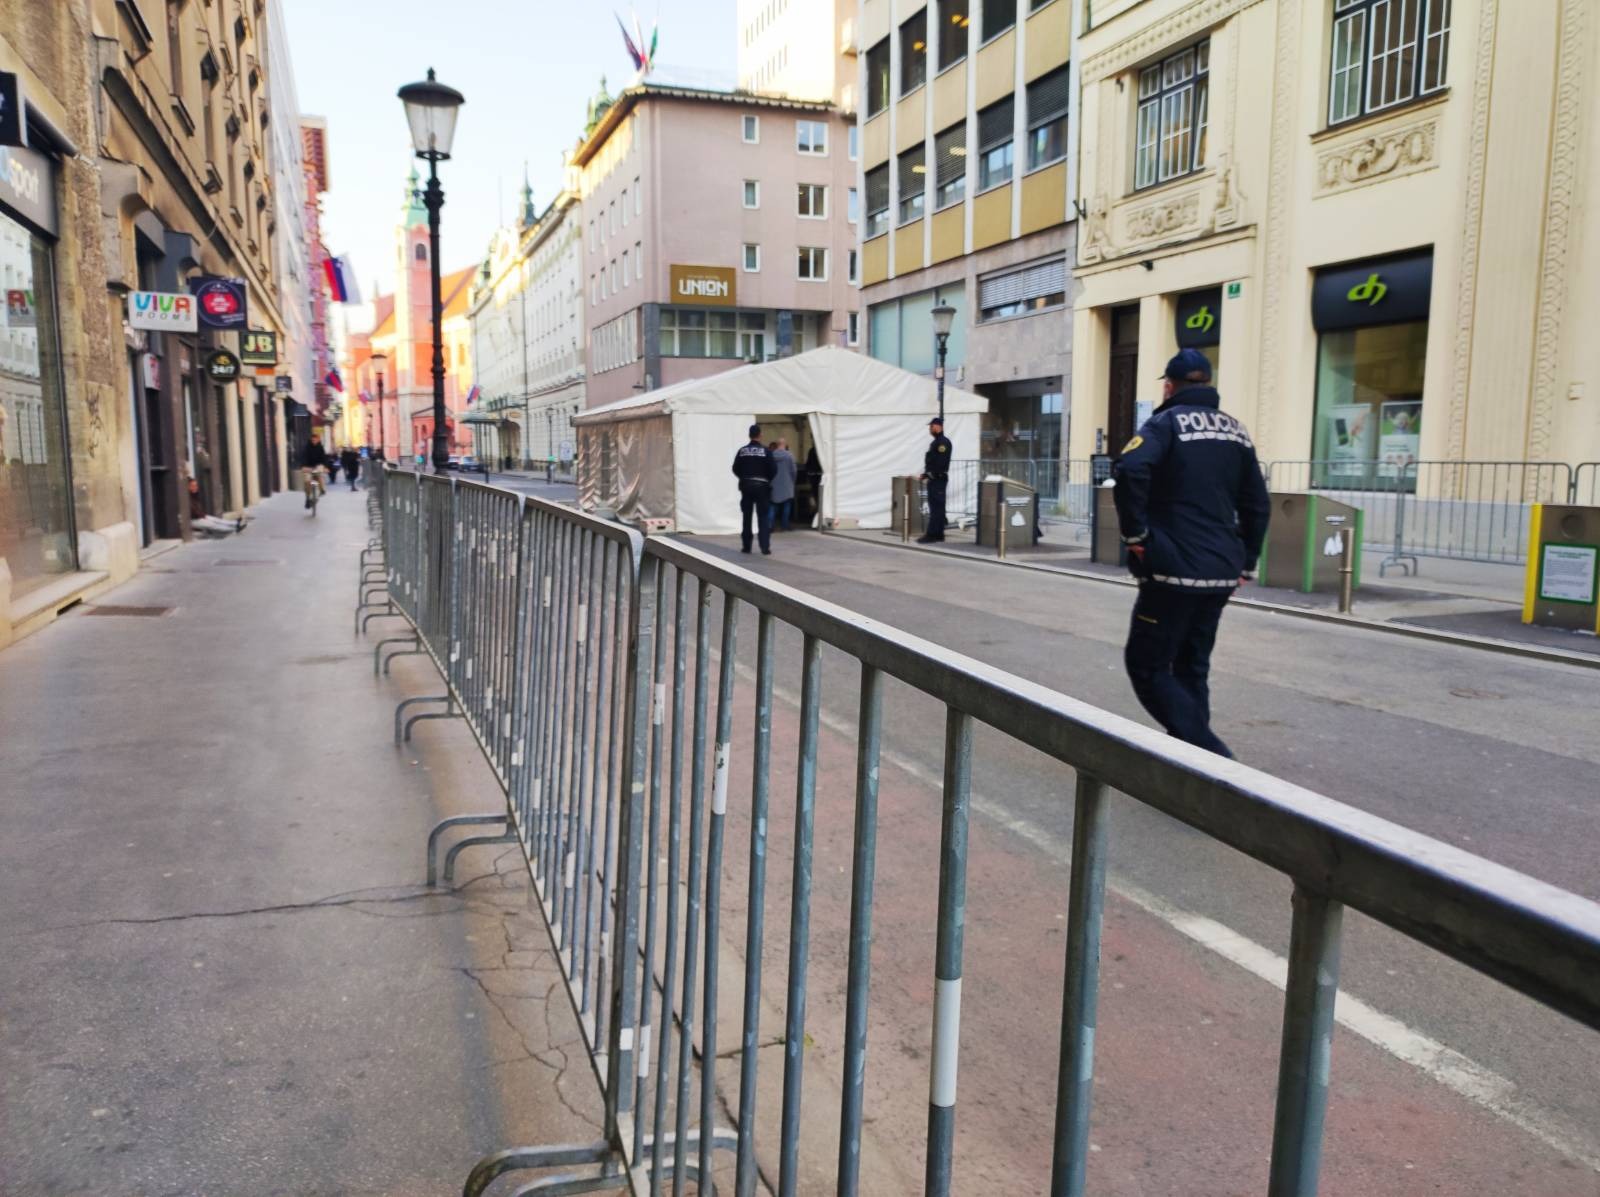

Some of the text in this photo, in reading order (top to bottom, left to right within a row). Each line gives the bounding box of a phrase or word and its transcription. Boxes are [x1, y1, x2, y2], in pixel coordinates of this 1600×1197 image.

[678, 279, 728, 297] UNION
[134, 292, 191, 313] VIVA
[135, 311, 191, 321] ROOMS
